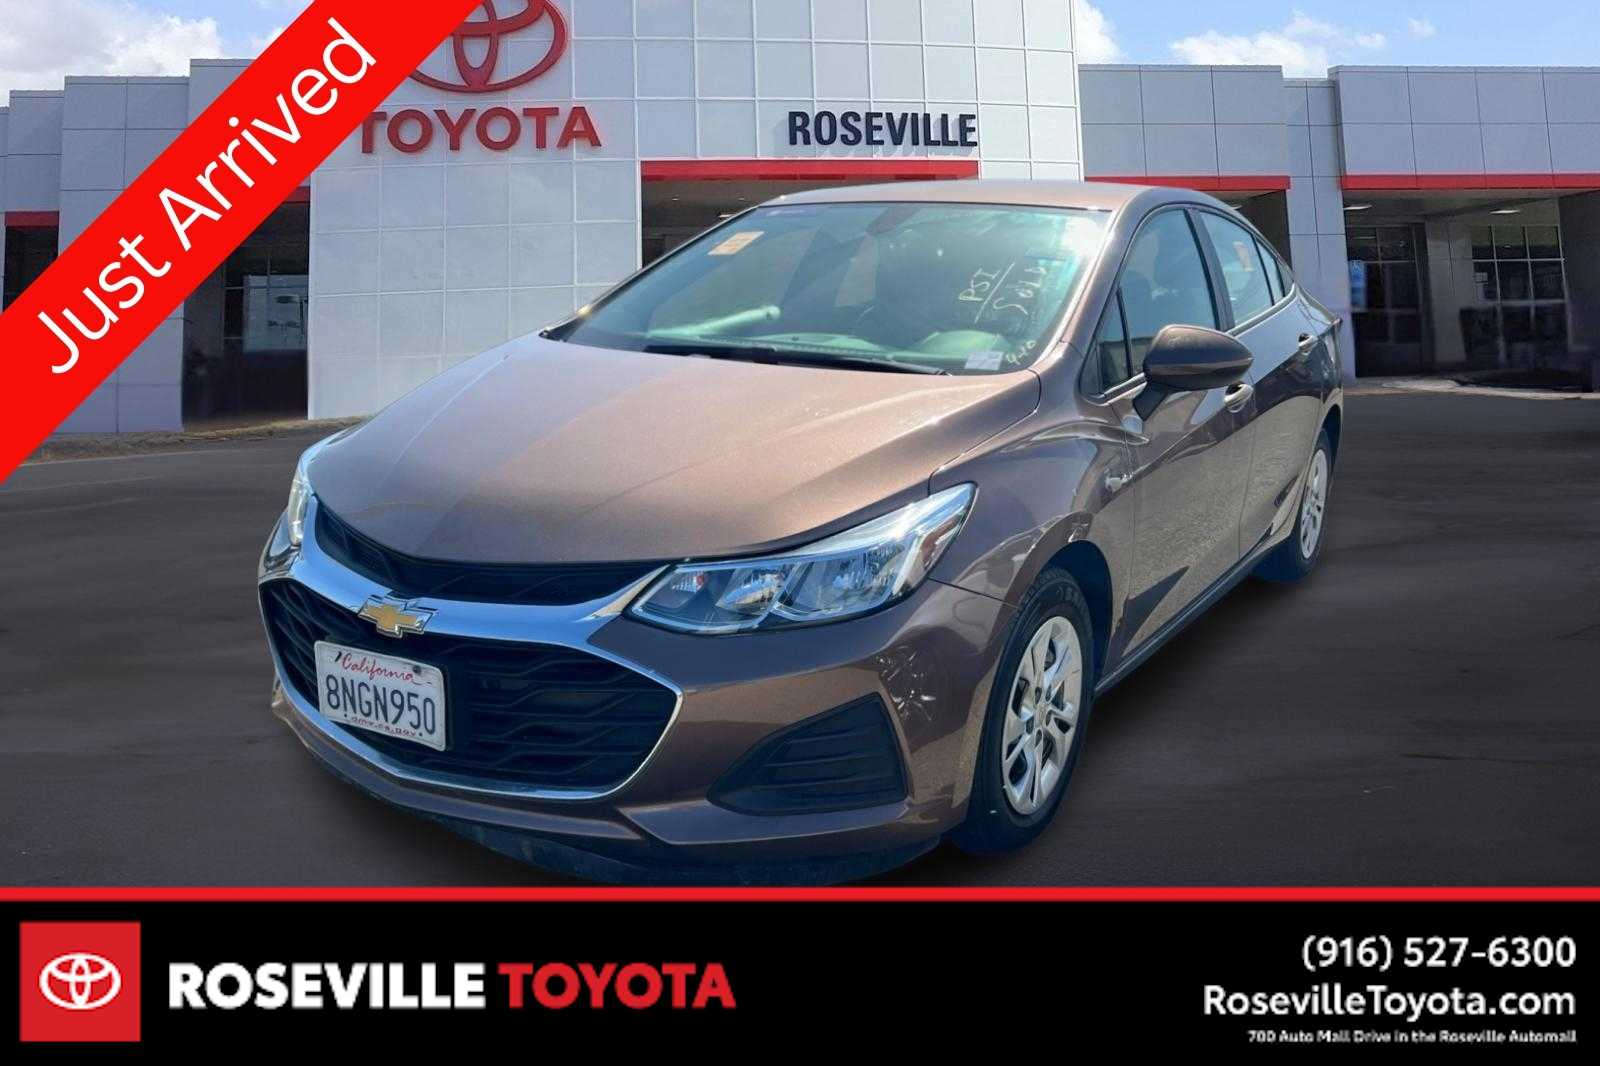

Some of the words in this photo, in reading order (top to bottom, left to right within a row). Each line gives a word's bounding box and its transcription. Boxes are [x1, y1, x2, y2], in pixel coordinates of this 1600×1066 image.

[361, 106, 602, 154] TOYOTA
[788, 110, 978, 147] ROSEVILLE
[339, 652, 421, 686] California
[325, 674, 436, 735] 8NGN950
